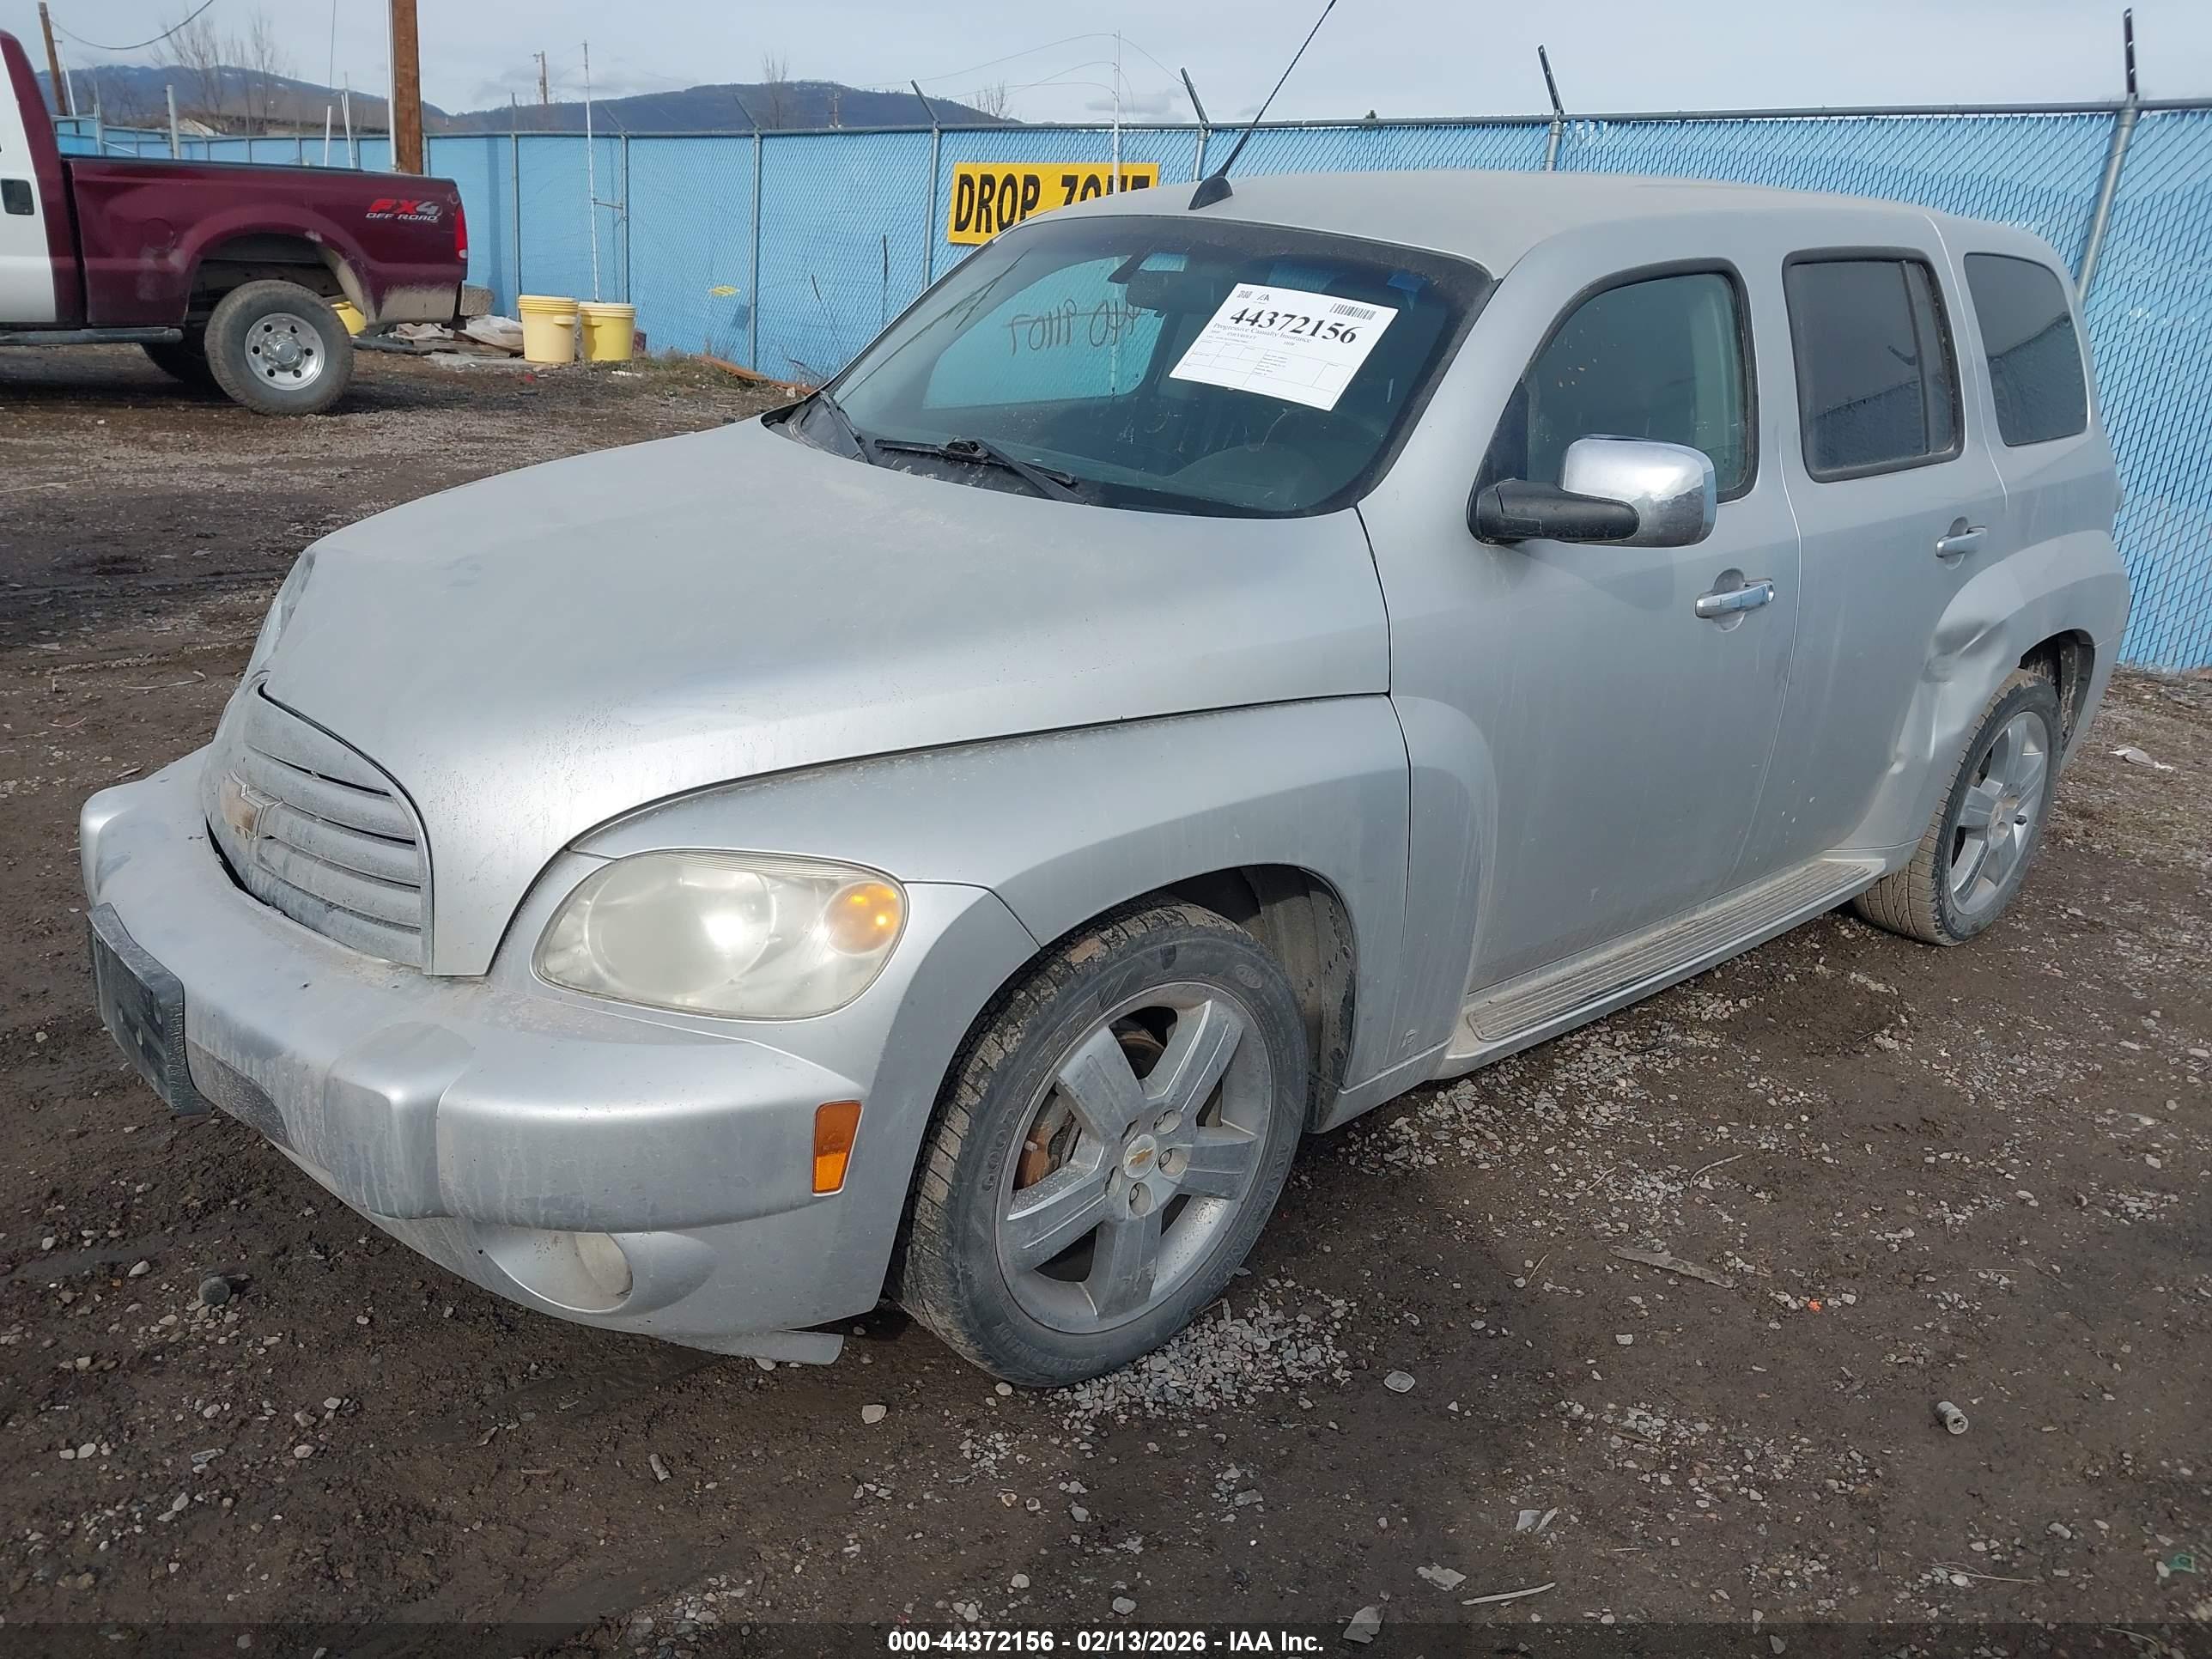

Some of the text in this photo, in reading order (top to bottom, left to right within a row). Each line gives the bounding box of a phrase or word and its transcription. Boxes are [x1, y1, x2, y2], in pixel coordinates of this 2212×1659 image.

[369, 198, 440, 215] FX4
[954, 173, 1041, 234] DROP
[1213, 323, 1250, 333] Progressive
[1251, 327, 1279, 338] Casualty
[1279, 332, 1313, 343] Insurance
[1229, 307, 1365, 344] 44372156
